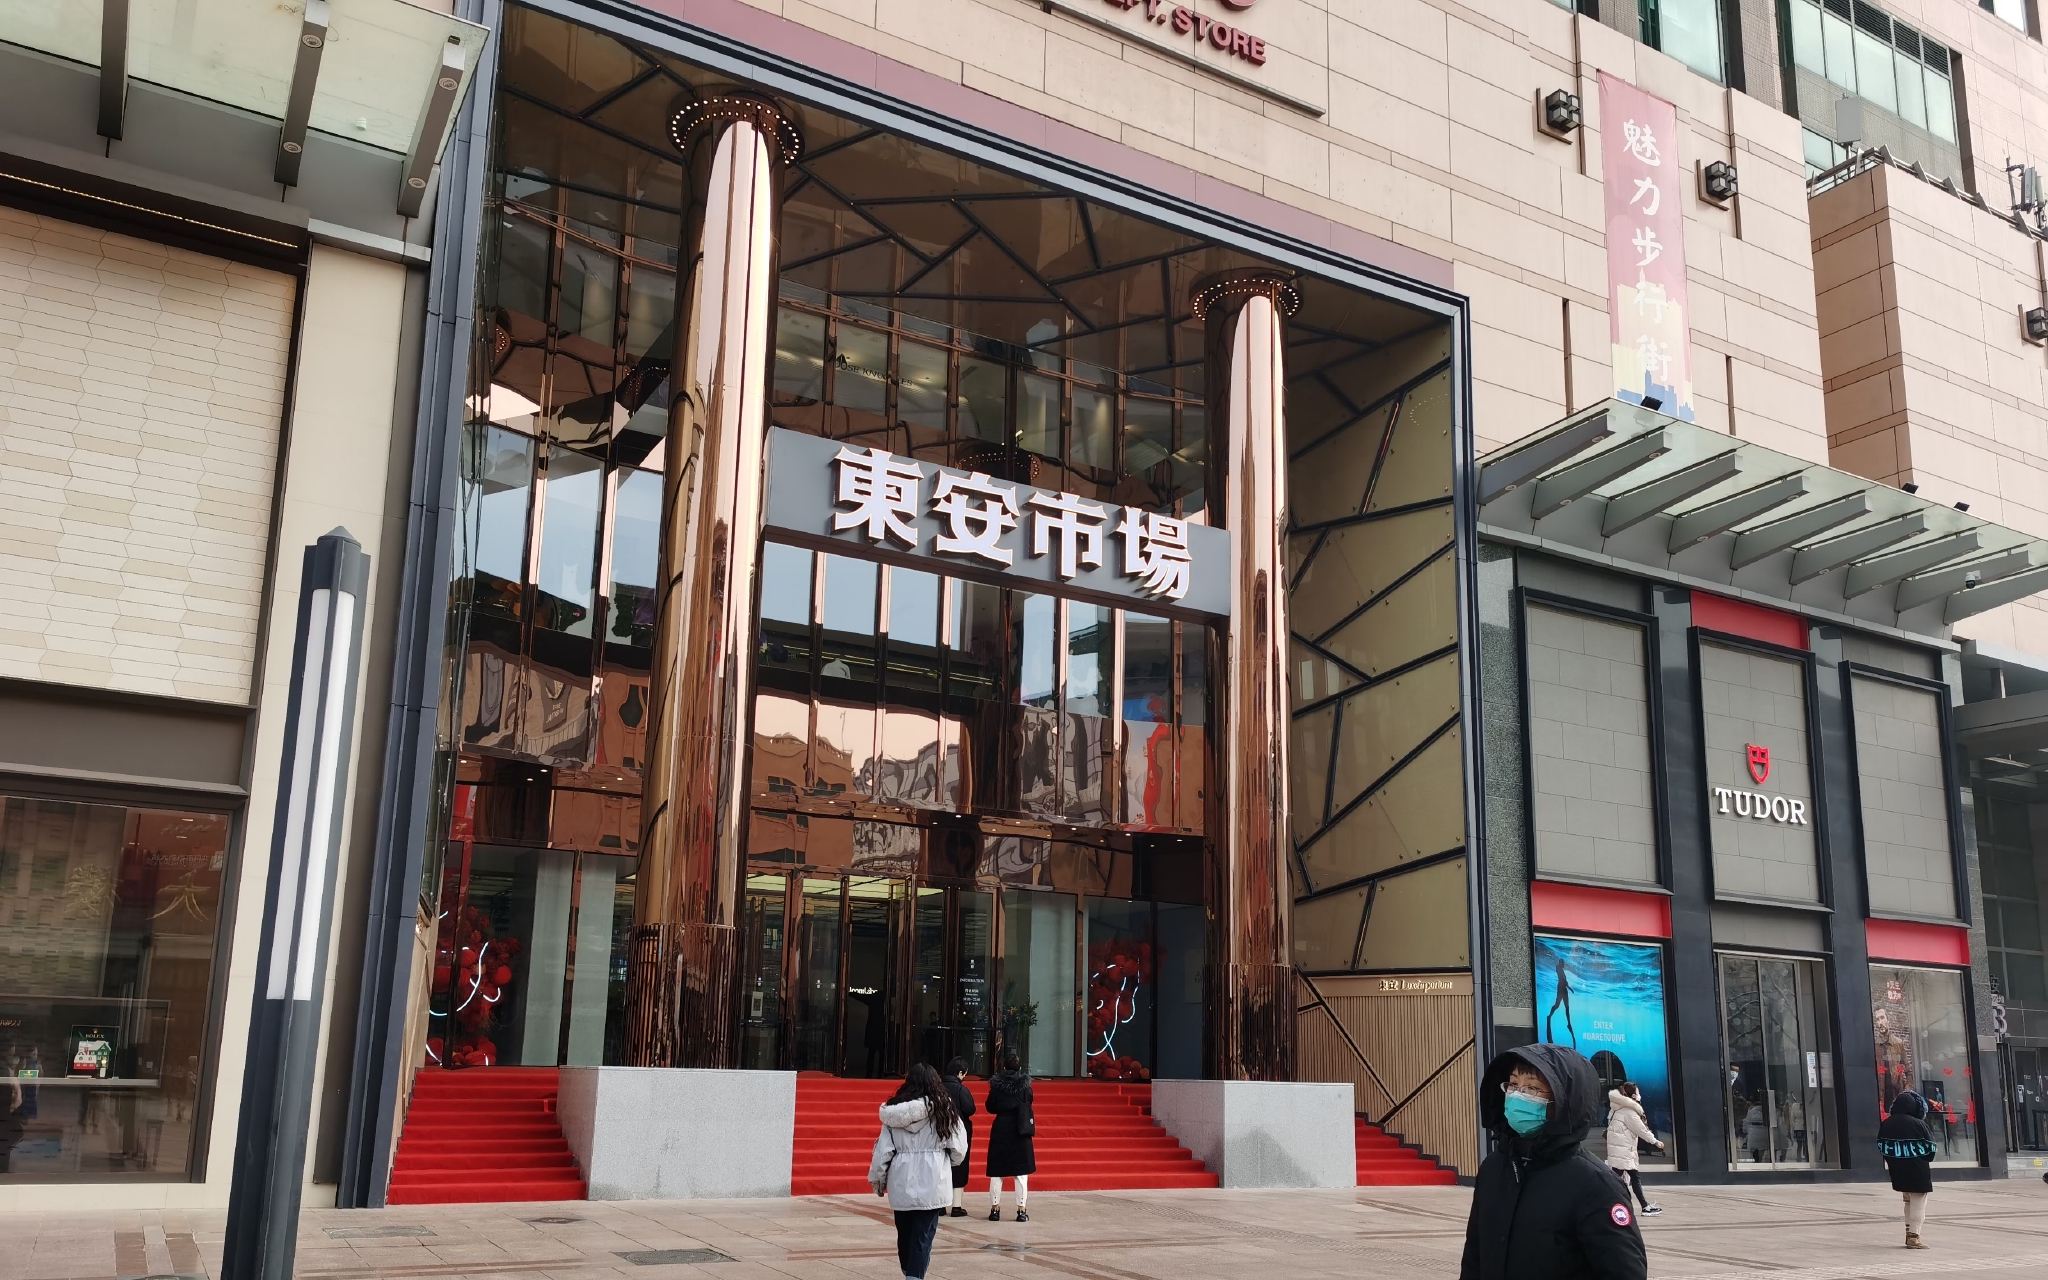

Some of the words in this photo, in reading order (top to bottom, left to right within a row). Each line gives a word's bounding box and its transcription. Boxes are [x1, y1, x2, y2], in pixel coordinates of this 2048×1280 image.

[1172, 5, 1266, 66] STORE
[1622, 118, 1672, 384] 魅力步行街
[829, 445, 1194, 601] 東安市場
[1713, 787, 1808, 825] TUDOR
[1593, 1020, 1614, 1030] ENTER
